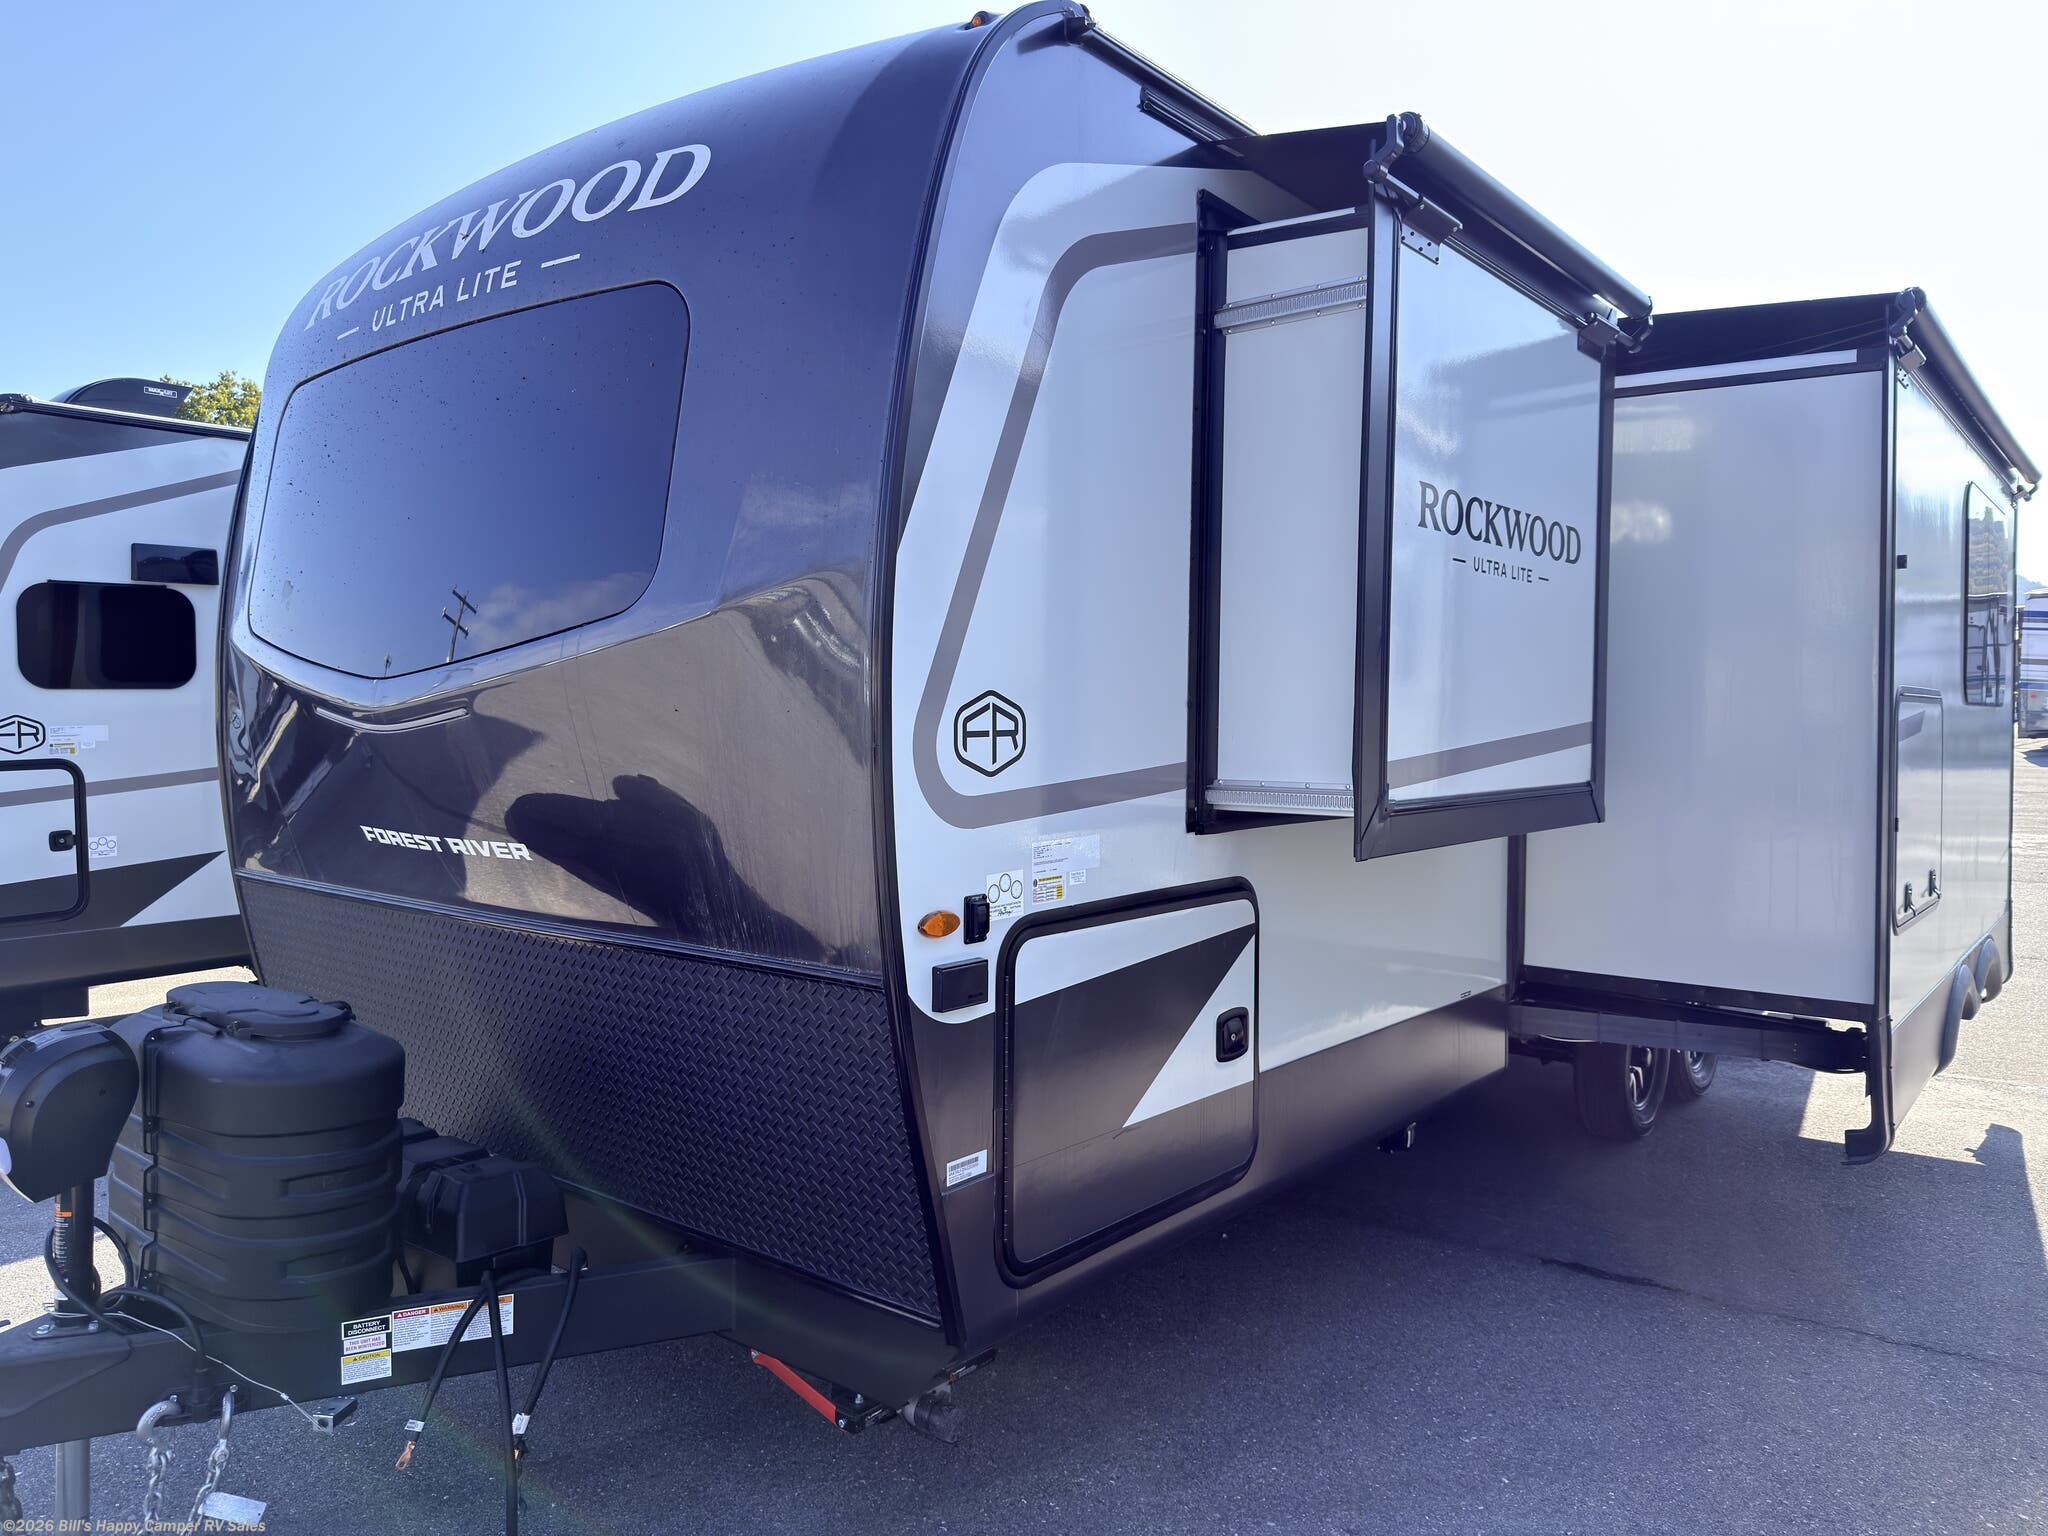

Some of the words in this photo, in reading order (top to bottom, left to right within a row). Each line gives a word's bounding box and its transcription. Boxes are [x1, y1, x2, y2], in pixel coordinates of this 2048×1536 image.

[304, 144, 712, 332] ROCKWOOD
[372, 284, 444, 332] ULTRA
[457, 260, 522, 302] LITE
[1418, 480, 1581, 565] ROCKWOOD
[1473, 556, 1507, 579] ULTRA
[1511, 565, 1533, 583] LITE
[359, 825, 443, 853] FOREST
[444, 837, 533, 861] RIVER
[402, 1308, 427, 1318] DANGER
[439, 1303, 465, 1312] WARNING
[348, 1325, 386, 1336] DISCONNECT
[353, 1321, 381, 1330] BATTERY
[358, 1352, 381, 1361] CAUTION
